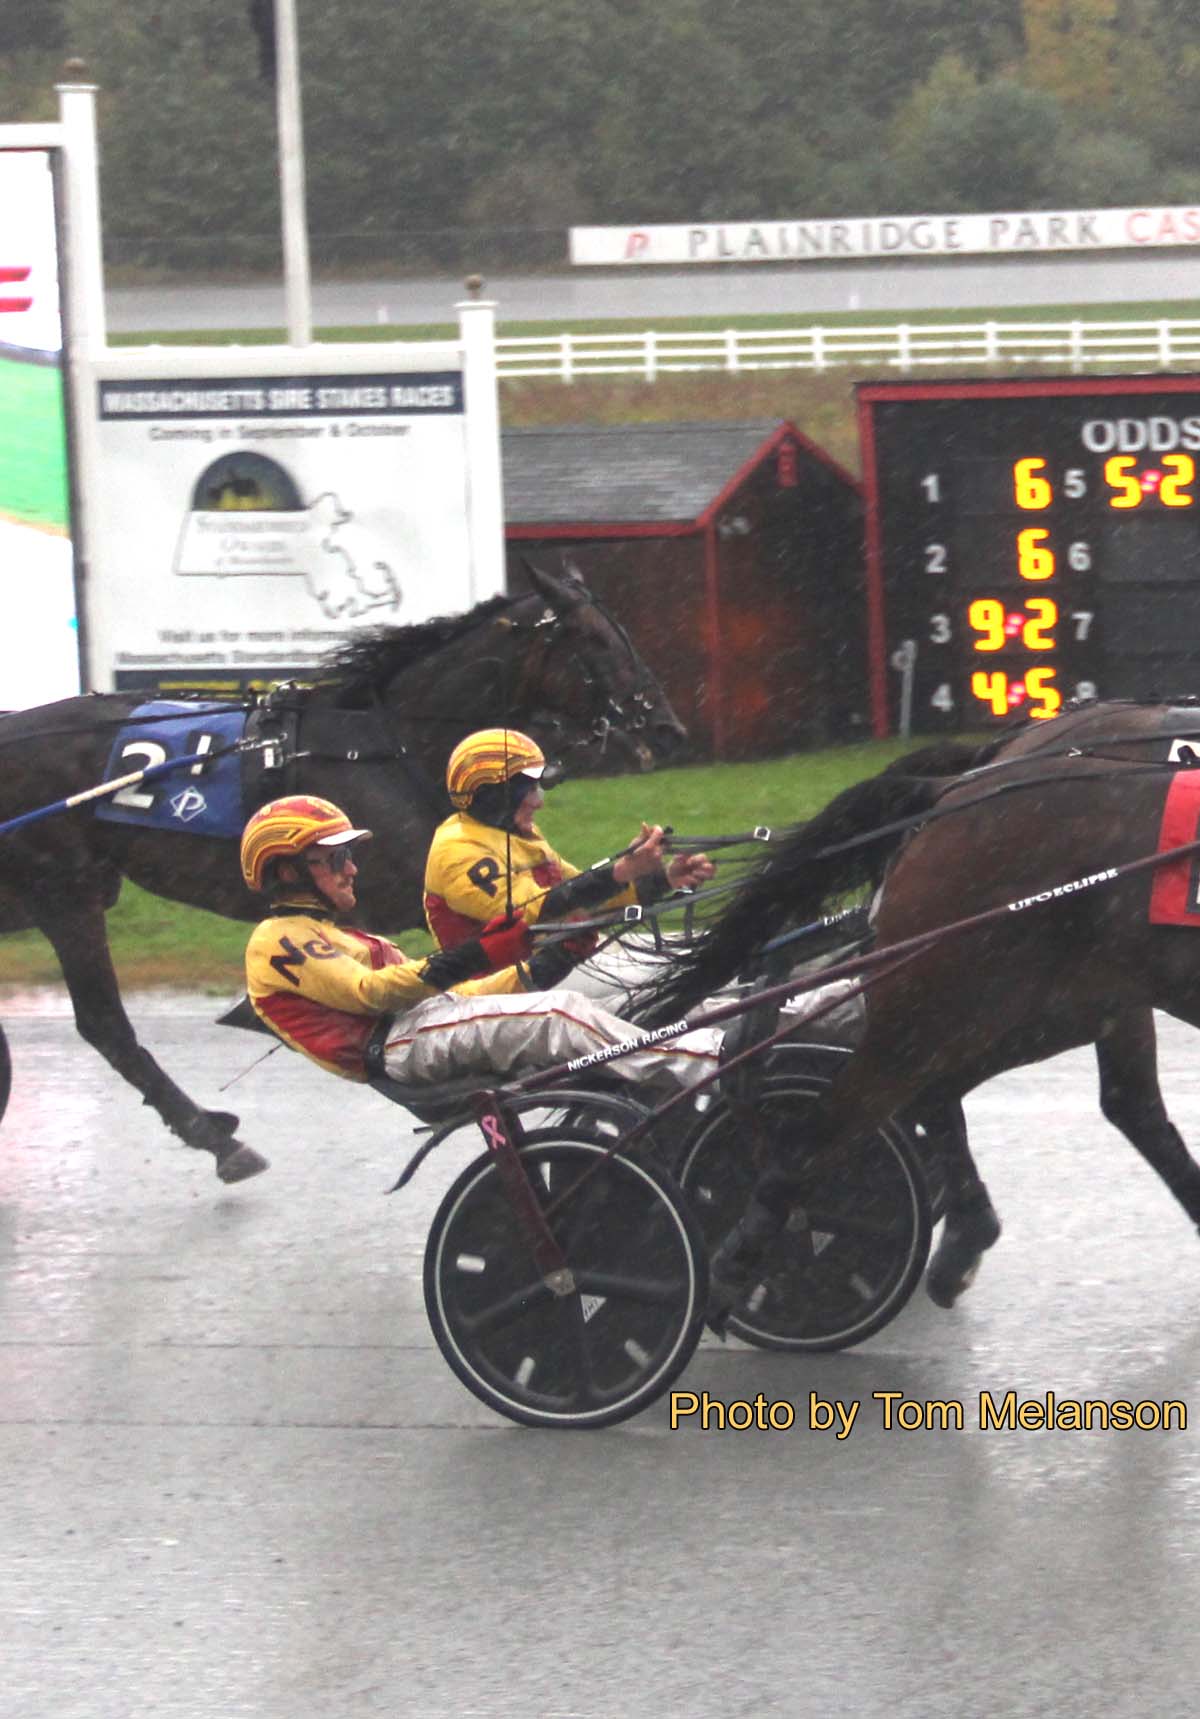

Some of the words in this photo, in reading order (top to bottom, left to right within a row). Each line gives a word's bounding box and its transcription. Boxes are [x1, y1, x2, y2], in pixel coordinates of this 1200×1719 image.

[688, 220, 961, 258] PLAINRIDGE
[988, 216, 1100, 248] PARK
[391, 386, 454, 407] RACES
[920, 474, 940, 503] 1
[1013, 457, 1053, 511] 6
[1064, 469, 1087, 498] 5
[925, 544, 947, 573] 2
[1016, 527, 1055, 581] 6
[1067, 541, 1091, 571] 6
[930, 614, 951, 644] 3
[1071, 613, 1093, 641] 7
[932, 684, 952, 712] 4
[112, 742, 166, 808] 2
[467, 857, 499, 899] P
[567, 1038, 639, 1071] NICKERSON
[641, 1020, 688, 1045] RACING
